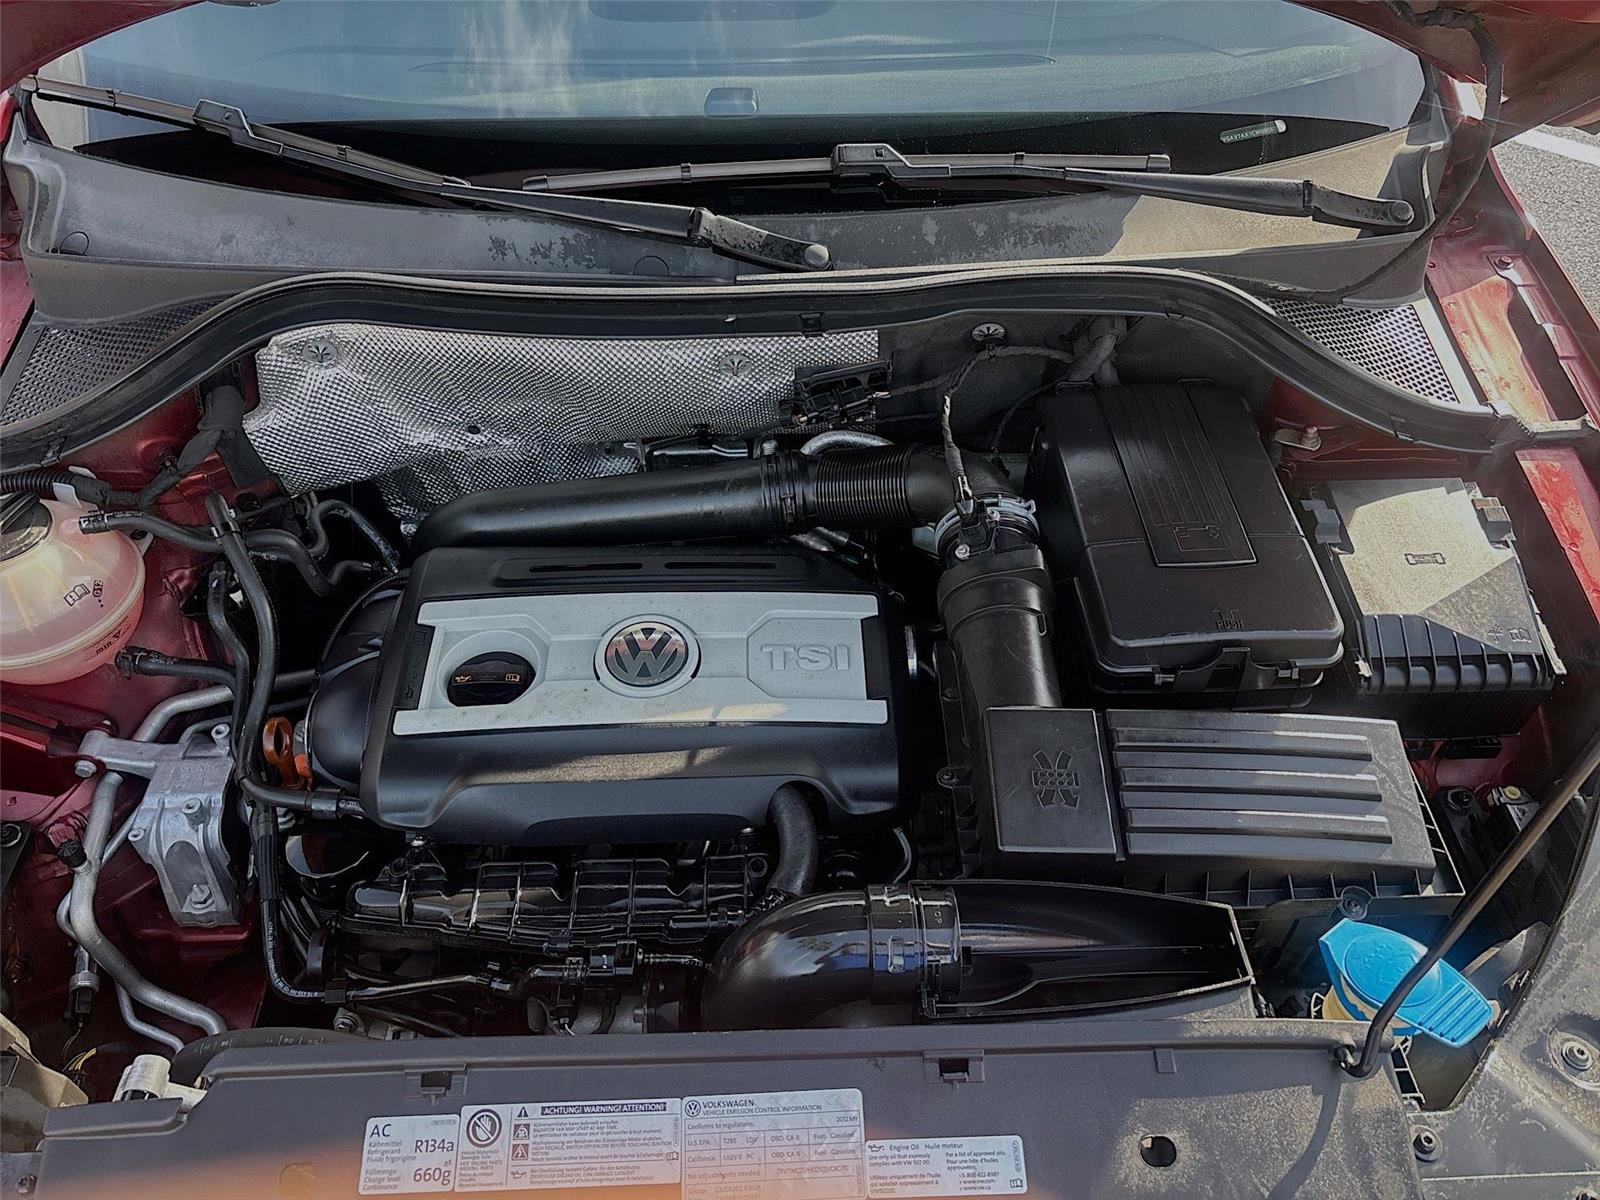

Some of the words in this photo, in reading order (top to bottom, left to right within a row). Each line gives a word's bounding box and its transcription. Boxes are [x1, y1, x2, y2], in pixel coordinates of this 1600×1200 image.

[761, 643, 850, 672] TSI
[543, 1106, 583, 1115] ACHTUNG!
[583, 1105, 622, 1114] WARNING!
[623, 1103, 665, 1113] ATTENTION!
[702, 1099, 755, 1109] VOLKSWAGEN
[725, 1107, 754, 1115] EMISSION
[782, 1104, 822, 1112] INFORMATION
[369, 1123, 392, 1138] AC
[415, 1138, 455, 1153] R134a
[889, 1144, 910, 1152] Engine
[911, 1143, 920, 1151] Oil
[367, 1147, 401, 1157] Refrigerant
[973, 1149, 996, 1158] approved
[878, 1154, 889, 1162] only
[869, 1160, 891, 1168] complies
[365, 1168, 397, 1177] Füllmenge
[413, 1167, 452, 1186] 660g
[364, 1176, 386, 1184] Charge
[386, 1175, 401, 1183] level
[362, 1183, 398, 1191] Contenance
